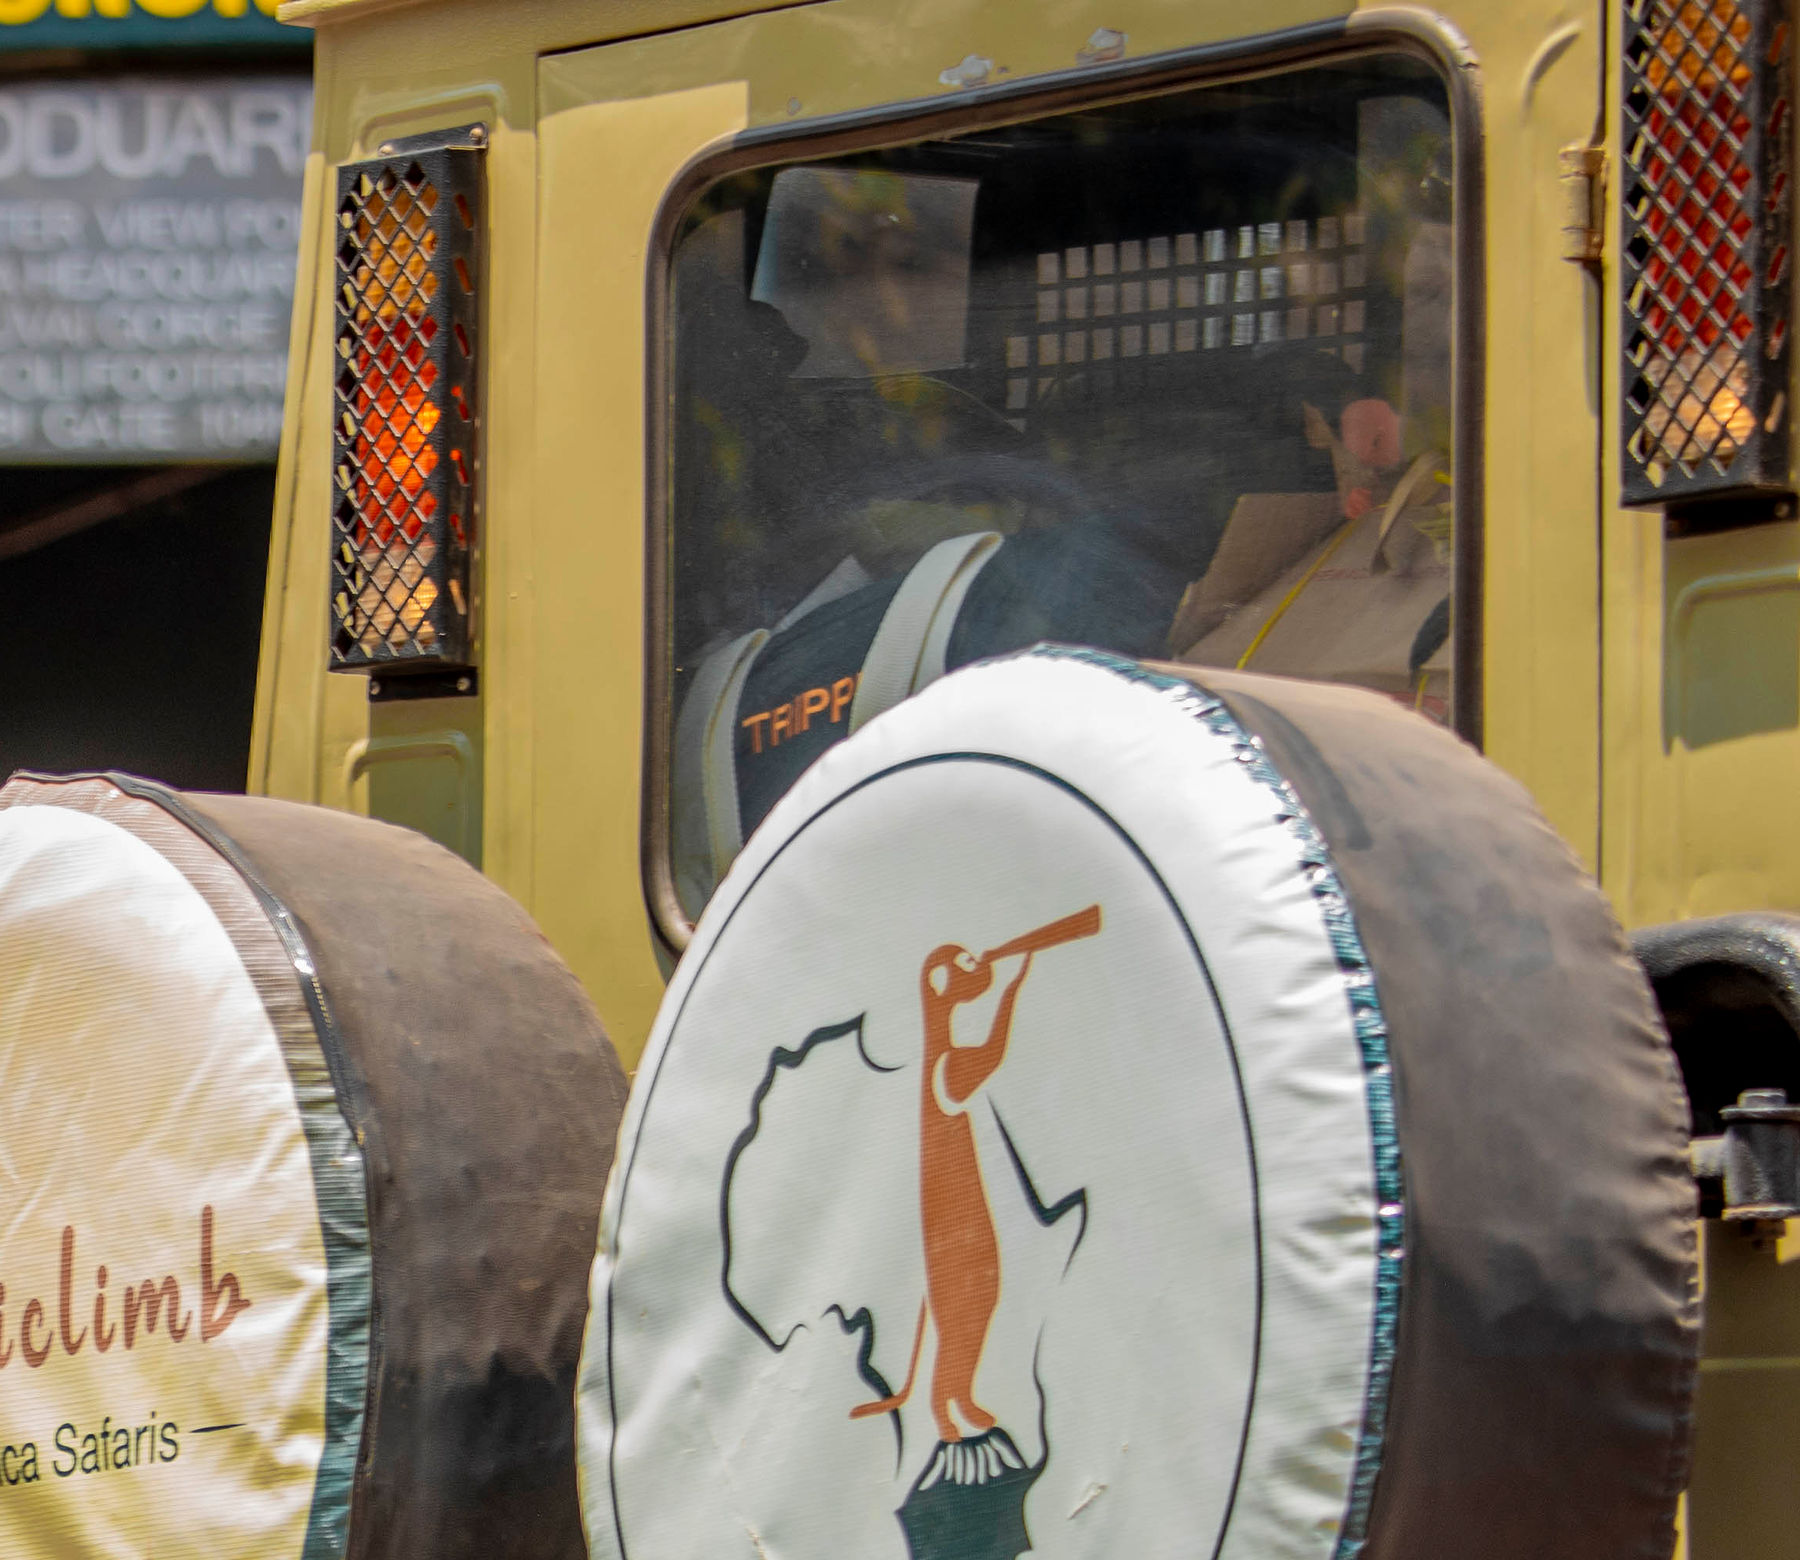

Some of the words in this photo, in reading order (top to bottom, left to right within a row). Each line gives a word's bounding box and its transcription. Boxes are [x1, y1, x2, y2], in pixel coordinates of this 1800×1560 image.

[96, 203, 221, 249] VIEW
[227, 203, 300, 248] PO
[27, 253, 296, 298] HEADQUAR
[99, 303, 282, 349] GORGE
[86, 353, 290, 398] FOOTPR
[45, 401, 180, 446] GATE
[741, 670, 864, 754] TRIPP
[53, 1411, 180, 1479] Safaris
